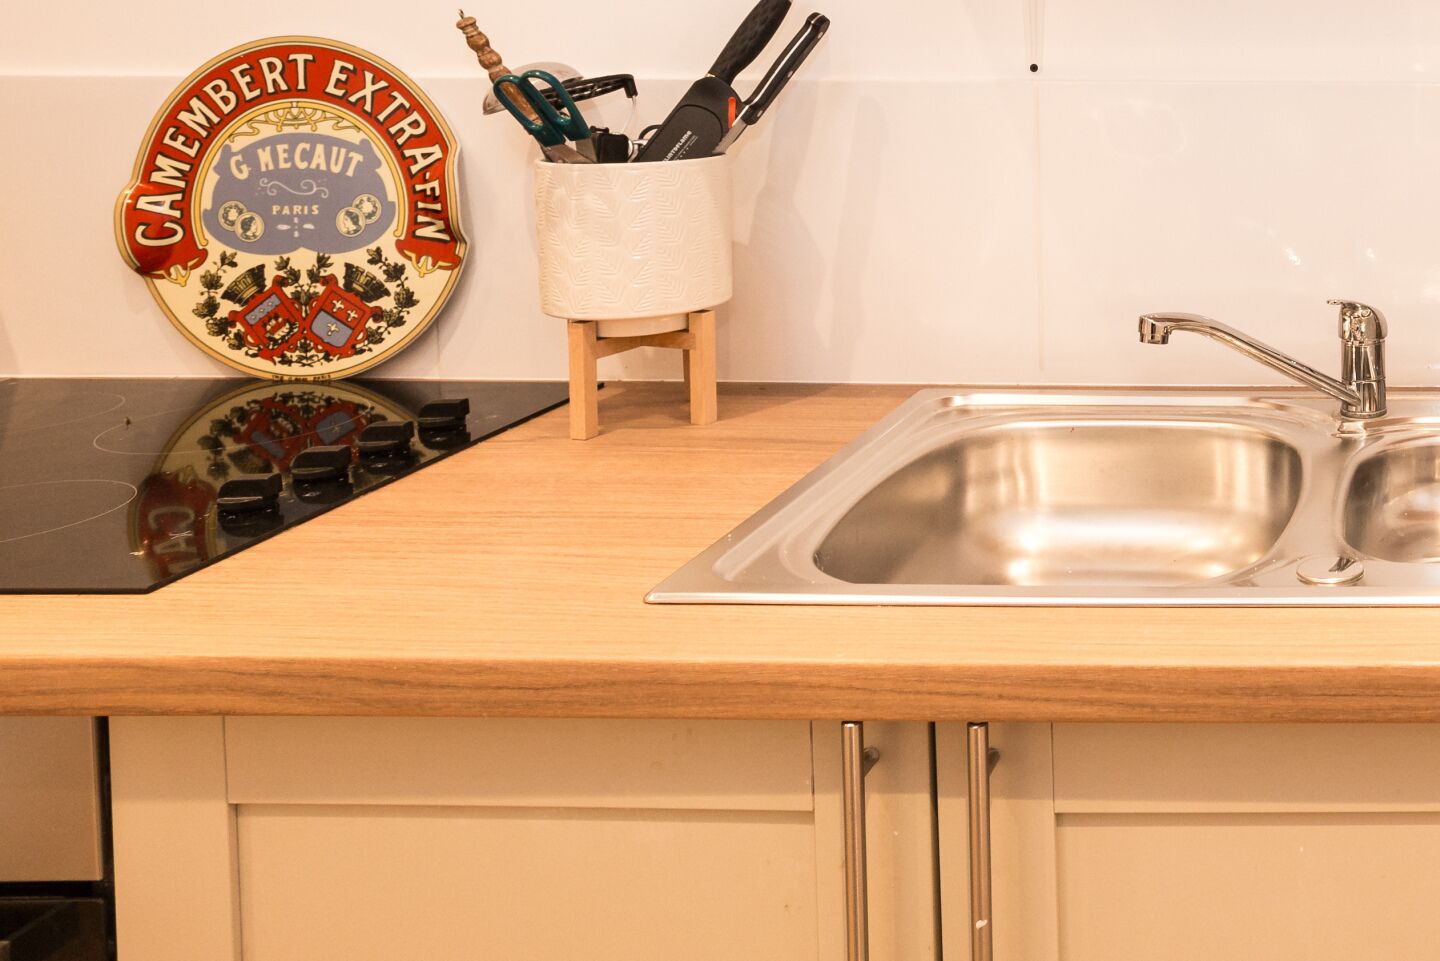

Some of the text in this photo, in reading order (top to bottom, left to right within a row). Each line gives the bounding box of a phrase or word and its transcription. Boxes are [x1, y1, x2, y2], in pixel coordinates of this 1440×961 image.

[134, 53, 315, 248] CAMEMBERT
[256, 142, 364, 178] MECAUT
[271, 204, 320, 216] PARIS
